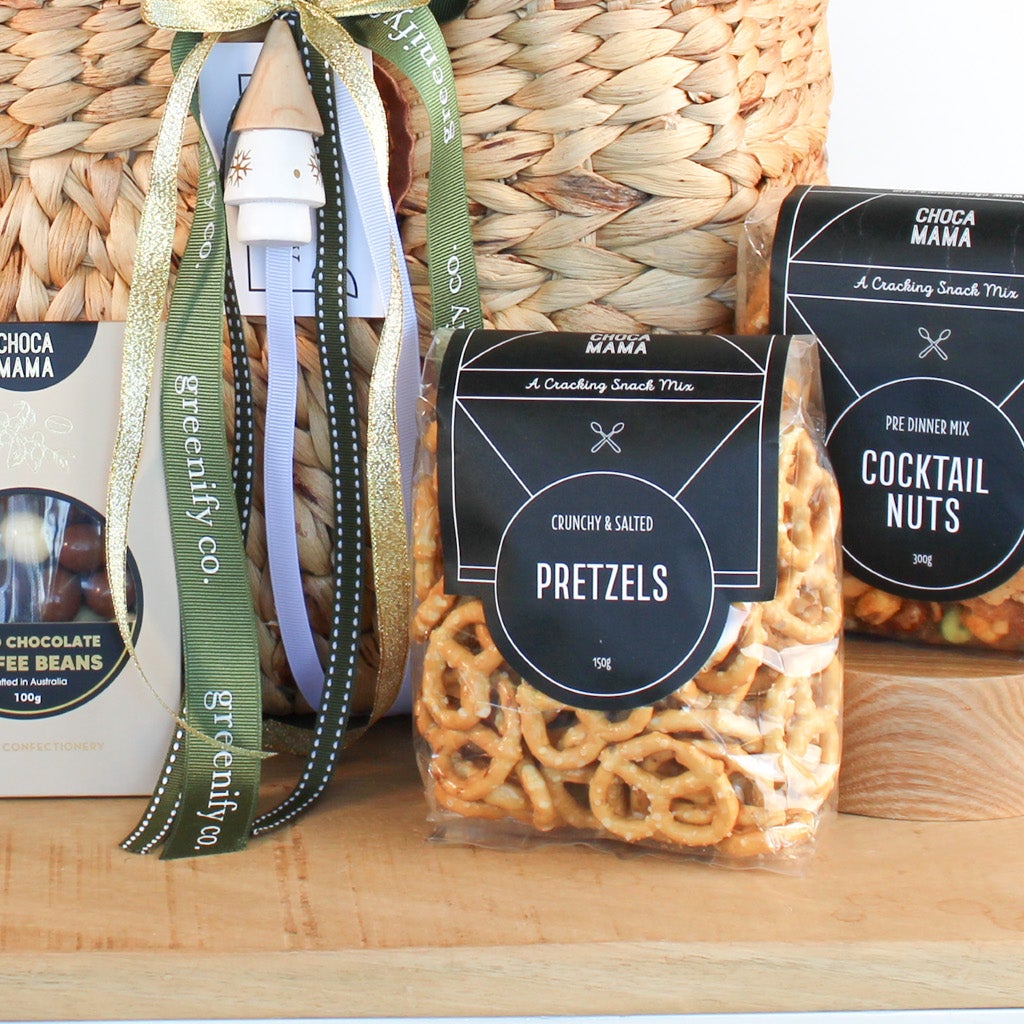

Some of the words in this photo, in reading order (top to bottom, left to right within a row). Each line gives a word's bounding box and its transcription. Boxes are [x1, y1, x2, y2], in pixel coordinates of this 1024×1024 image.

[383, 9, 456, 144] greenify
[915, 207, 975, 226] CHOCA
[910, 225, 972, 248] MAMA
[854, 276, 868, 289] A
[872, 277, 934, 298] Cracking
[937, 281, 980, 297] Snack
[984, 283, 1019, 299] Mix
[585, 341, 647, 354] MAMA
[525, 378, 540, 390] A
[544, 378, 606, 394] Cracking
[611, 378, 655, 392] Snack
[657, 378, 694, 392] Mix
[886, 415, 905, 431] PRE
[908, 417, 947, 435] DINNER
[950, 421, 970, 436] MIX
[175, 375, 220, 527] greenify
[198, 536, 219, 584] co.
[861, 449, 989, 494] COCKTAIL
[887, 493, 960, 533] NUTS
[551, 515, 601, 531] CRUNCHY
[605, 516, 612, 531] &
[614, 515, 654, 532] SALTED
[913, 554, 932, 567] 300g
[537, 563, 668, 601] PRETZELS
[6, 635, 101, 648] CHOCOLATE
[35, 655, 103, 671] BEANS
[592, 657, 612, 671] 150g
[20, 678, 28, 686] in
[30, 677, 68, 686] Australia
[14, 693, 41, 704] 100g
[2, 742, 104, 752] CONFECTIONERY
[197, 690, 240, 821] greenify
